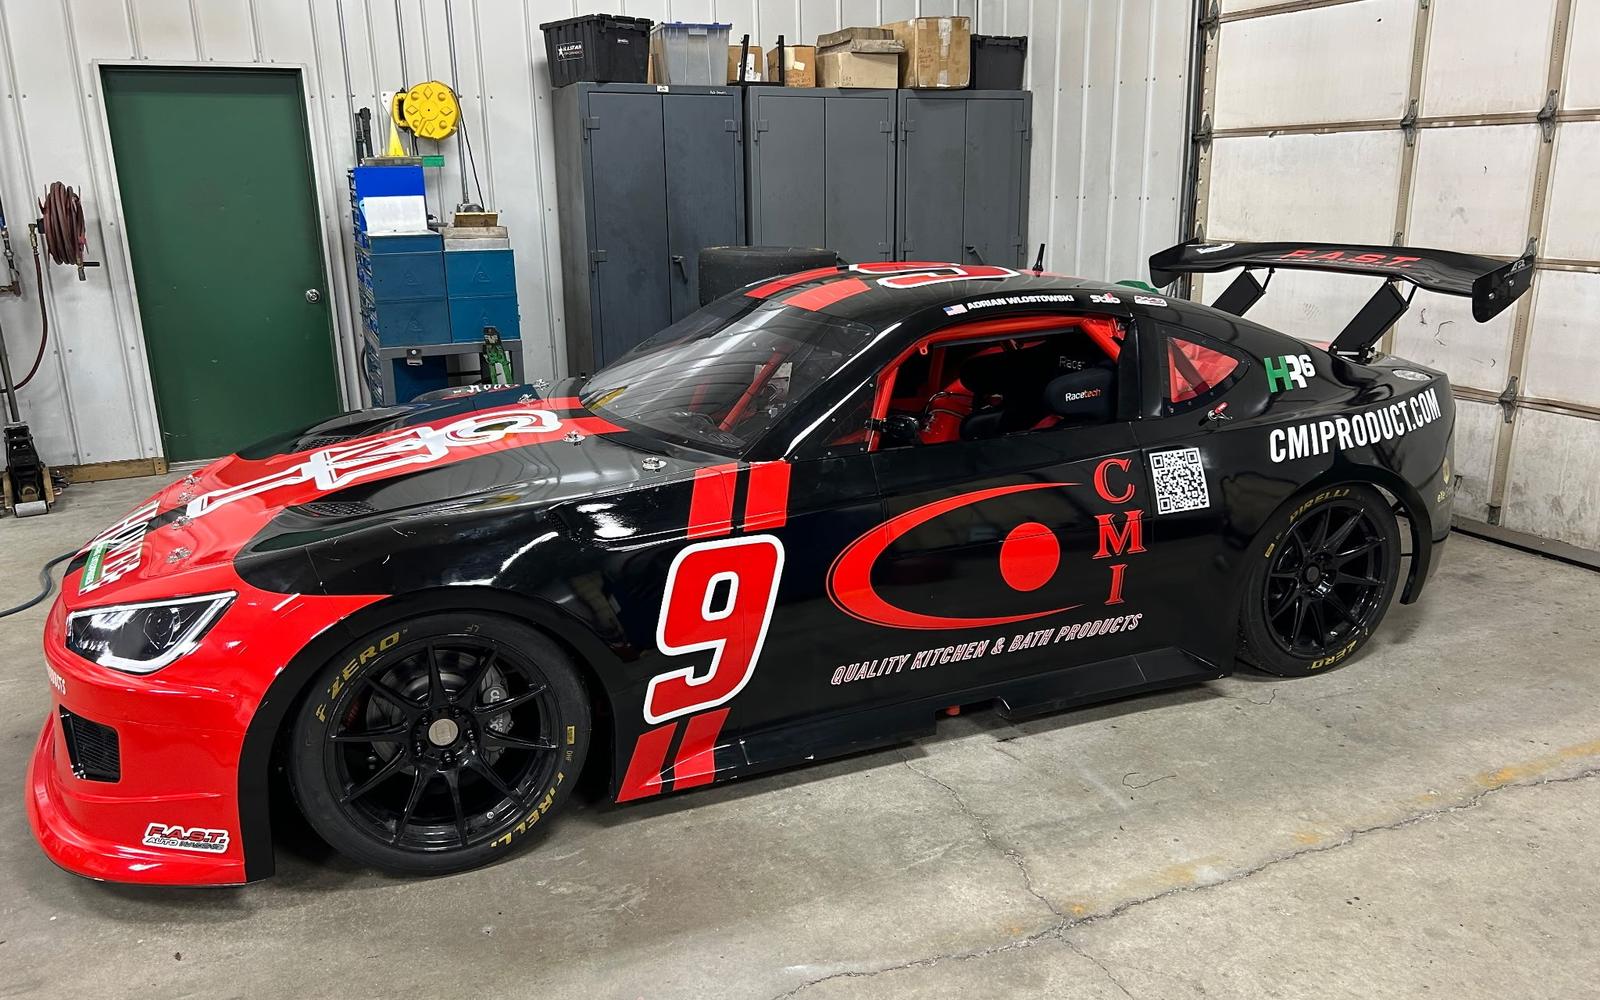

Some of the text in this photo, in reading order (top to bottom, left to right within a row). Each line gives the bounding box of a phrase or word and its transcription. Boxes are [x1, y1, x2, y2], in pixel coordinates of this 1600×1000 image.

[966, 298, 1007, 310] ADRIAN
[1263, 354, 1316, 393] HR6
[1065, 388, 1102, 402] Racetech
[1269, 387, 1442, 464] CMIPRODUCT.COM
[643, 533, 786, 726] 9
[830, 612, 1144, 686] QUALITY KITCHEN & BATH PRODUCTS
[327, 631, 401, 701] ZERO
[145, 836, 179, 847] AUTO
[146, 824, 228, 844] F.A.S.T.
